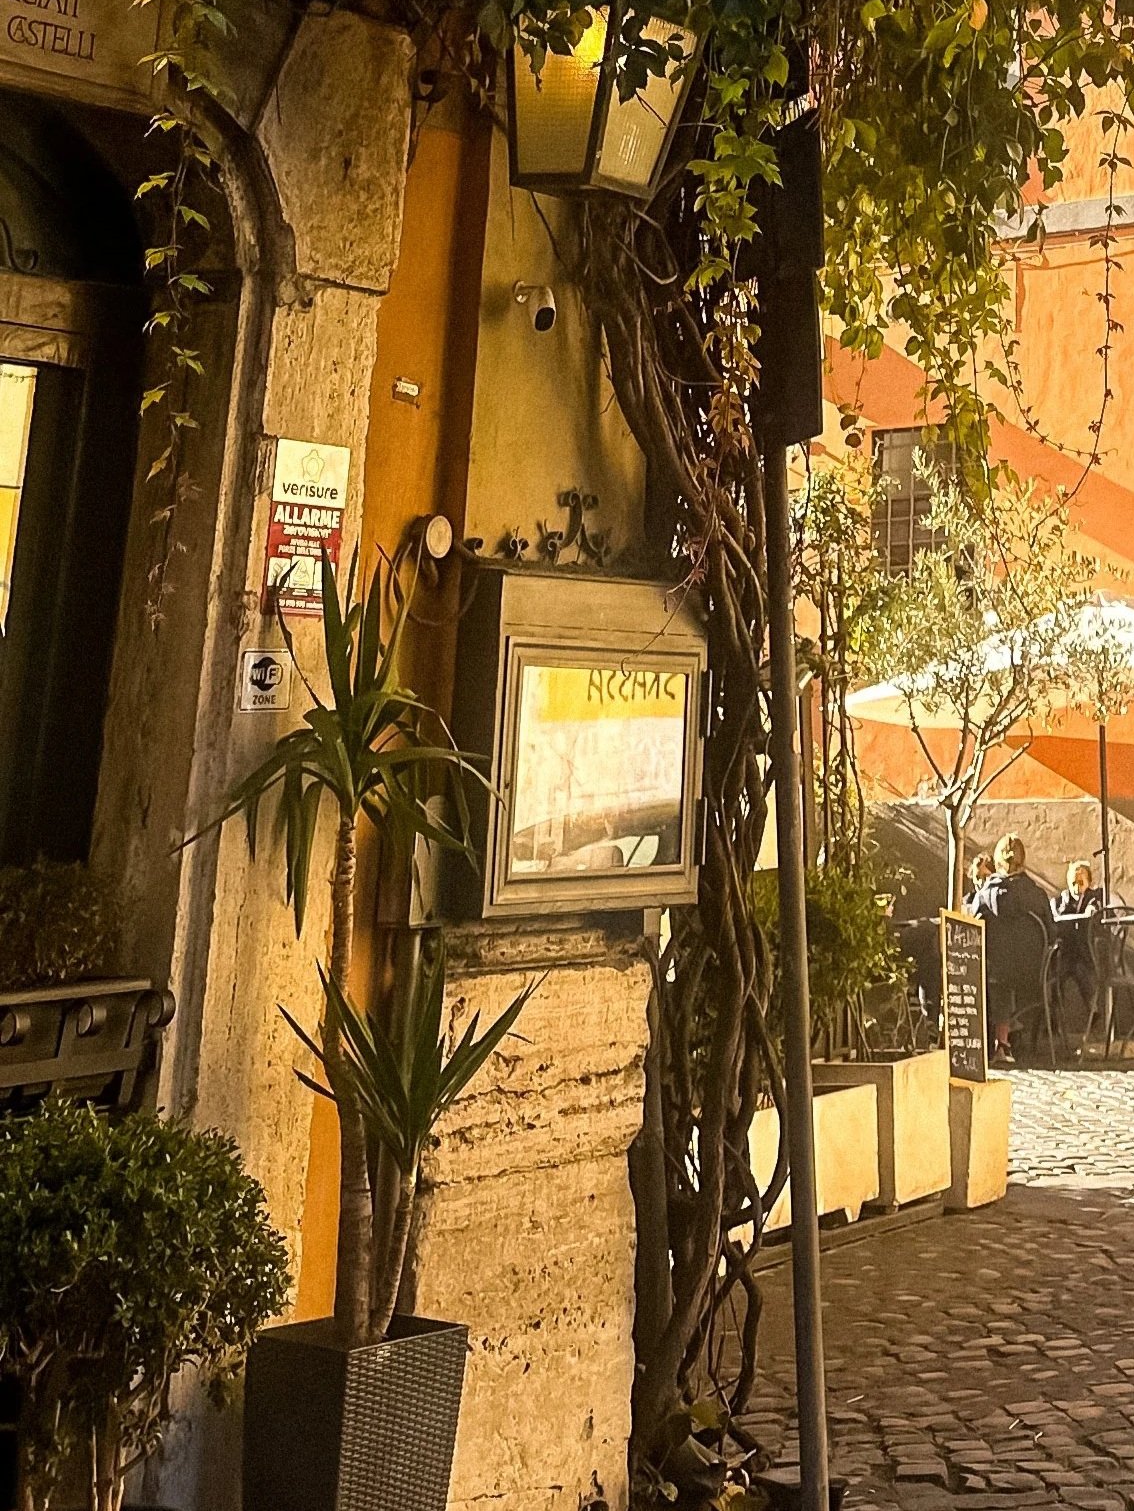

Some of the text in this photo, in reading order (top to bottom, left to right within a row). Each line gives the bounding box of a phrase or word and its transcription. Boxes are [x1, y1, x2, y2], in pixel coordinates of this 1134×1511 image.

[282, 482, 338, 499] verisure
[274, 504, 341, 529] ALLARME
[252, 694, 276, 705] ZONE
